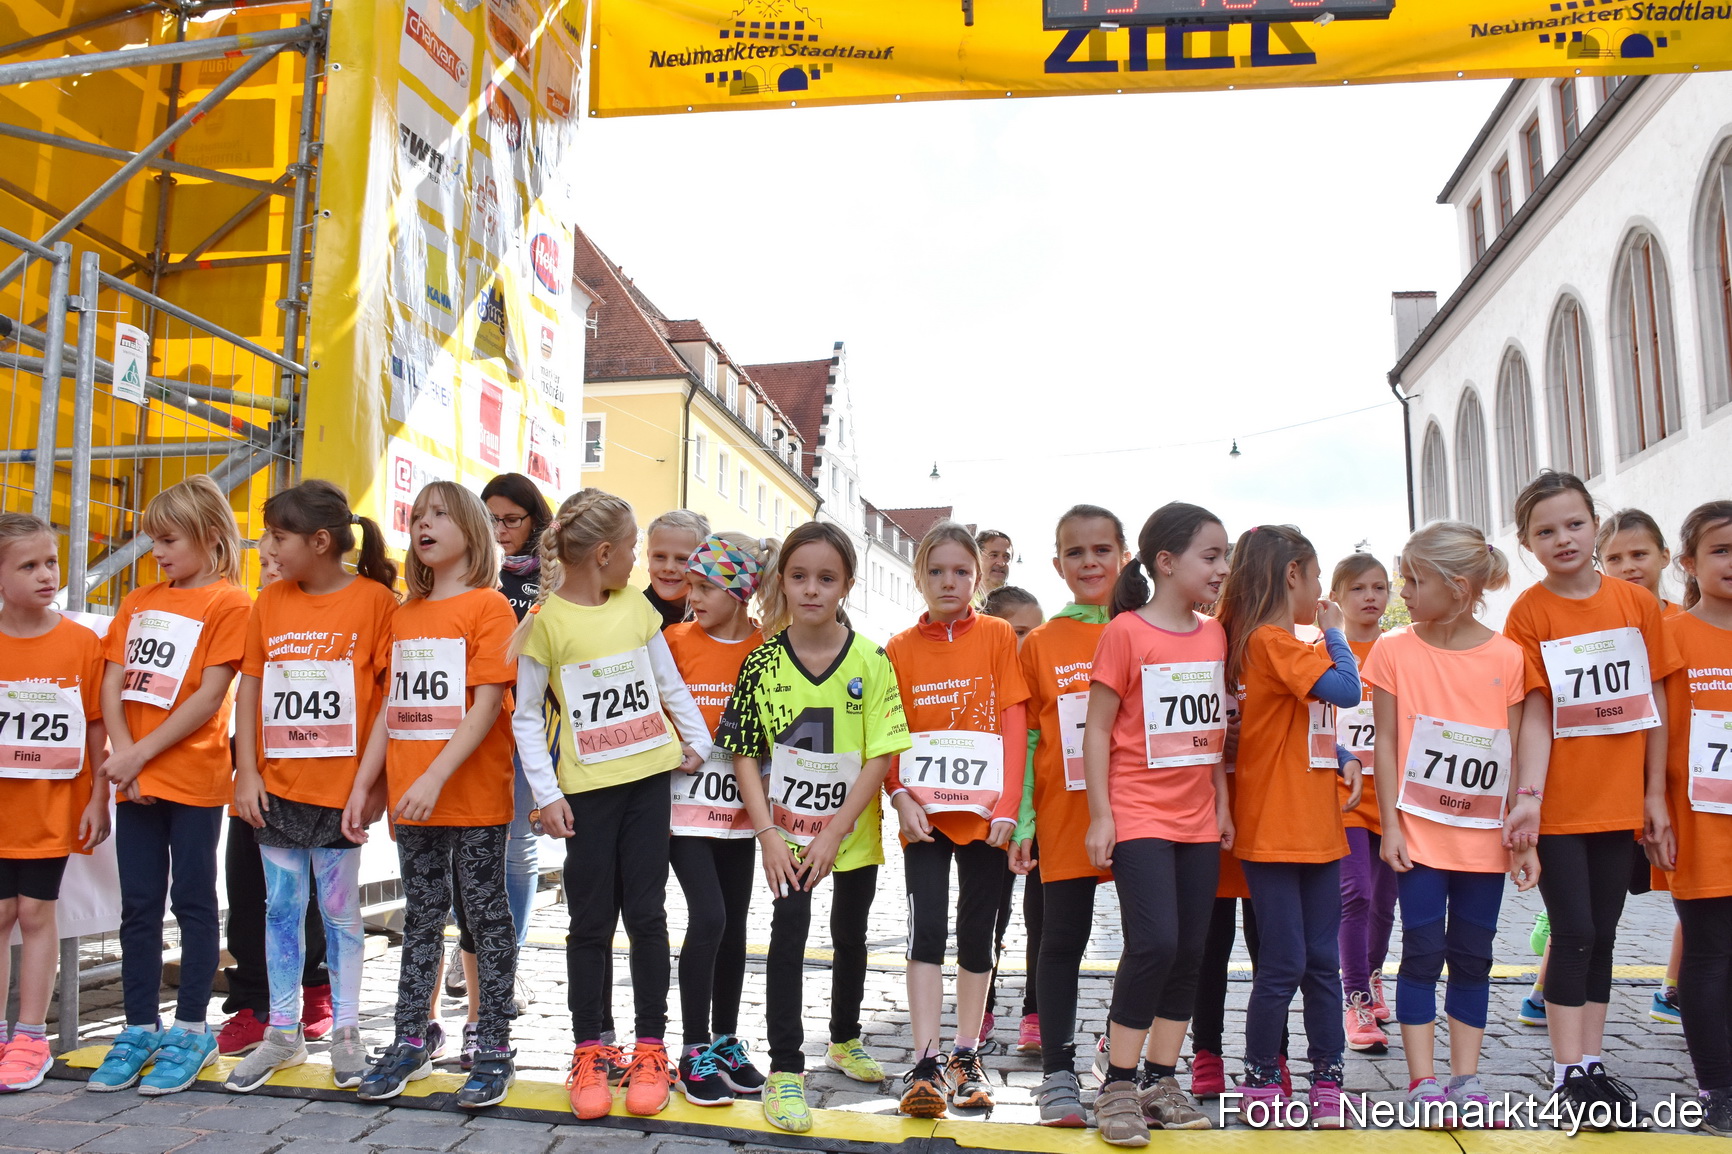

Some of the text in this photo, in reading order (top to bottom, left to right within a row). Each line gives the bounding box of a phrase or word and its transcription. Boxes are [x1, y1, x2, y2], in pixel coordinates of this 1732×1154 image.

[1469, 0, 1732, 38] Neumarkter Stadtlau
[648, 42, 894, 69] Neumarkter Stadtlauf
[269, 630, 328, 647] Neumarkter
[1585, 640, 1615, 652] BOCK
[127, 637, 176, 669] 7399
[291, 670, 325, 678] BOCK
[603, 661, 634, 676] BOCK
[1181, 672, 1212, 681] BOCK
[1565, 660, 1631, 699] 7107
[395, 671, 449, 701] 7146
[686, 682, 735, 693] eumarkt
[20, 692, 57, 701] BOCK
[582, 680, 649, 722] 7245
[694, 696, 731, 709] dtlauf
[273, 691, 340, 720] 7043
[846, 702, 862, 711] Par
[1159, 693, 1221, 727] 7002
[1594, 706, 1624, 718] Tessa
[398, 712, 433, 723] Felicitas
[1319, 700, 1334, 729] 71
[0, 711, 69, 742] 7125
[288, 730, 319, 742] Marie
[579, 717, 664, 752] MADLEN
[1192, 736, 1209, 748] Eva
[1348, 725, 1375, 747] 72
[1454, 732, 1493, 747] BOCK
[940, 739, 974, 747] BOCK
[14, 751, 41, 762] Finia
[711, 752, 733, 761] BOC
[805, 760, 838, 771] BOCK
[915, 756, 988, 786] 7187
[1423, 749, 1499, 791] 7100
[782, 775, 847, 811] 7259
[934, 791, 969, 801] Sophia
[1439, 794, 1471, 811] Gloria
[708, 810, 733, 822] Anna
